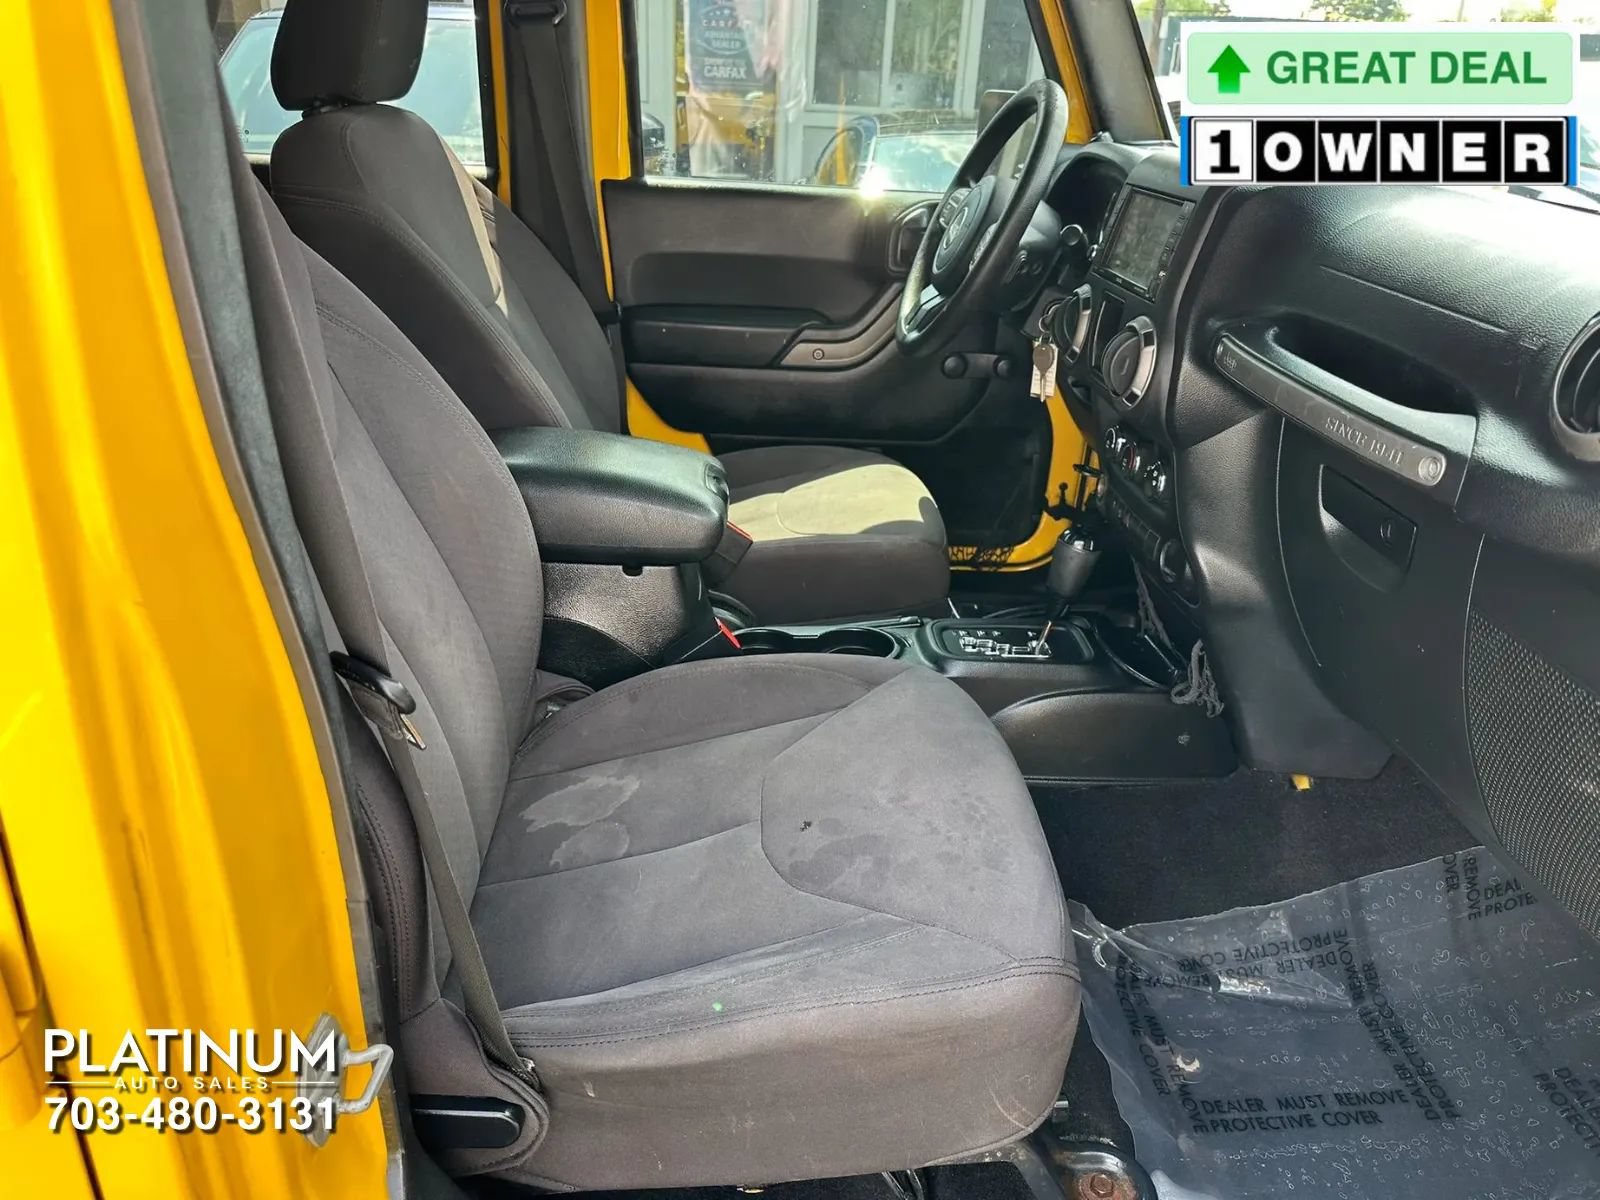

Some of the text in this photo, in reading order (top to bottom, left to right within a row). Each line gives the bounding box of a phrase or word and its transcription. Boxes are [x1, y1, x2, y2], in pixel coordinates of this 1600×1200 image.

[704, 66, 746, 79] CARFAX
[1325, 417, 1368, 446] SINCE
[1485, 892, 1537, 916] PROTE
[1177, 931, 1330, 973] PROTECTIVE COVER
[1276, 950, 1337, 974] DEALER
[1138, 1042, 1172, 1097] COVER
[1144, 1015, 1175, 1056] MUST
[1166, 1064, 1209, 1134] REMOVE
[1201, 1089, 1410, 1115] DEALER MUST REMOVE
[1212, 1110, 1383, 1133] PROTECTIVE COVER
